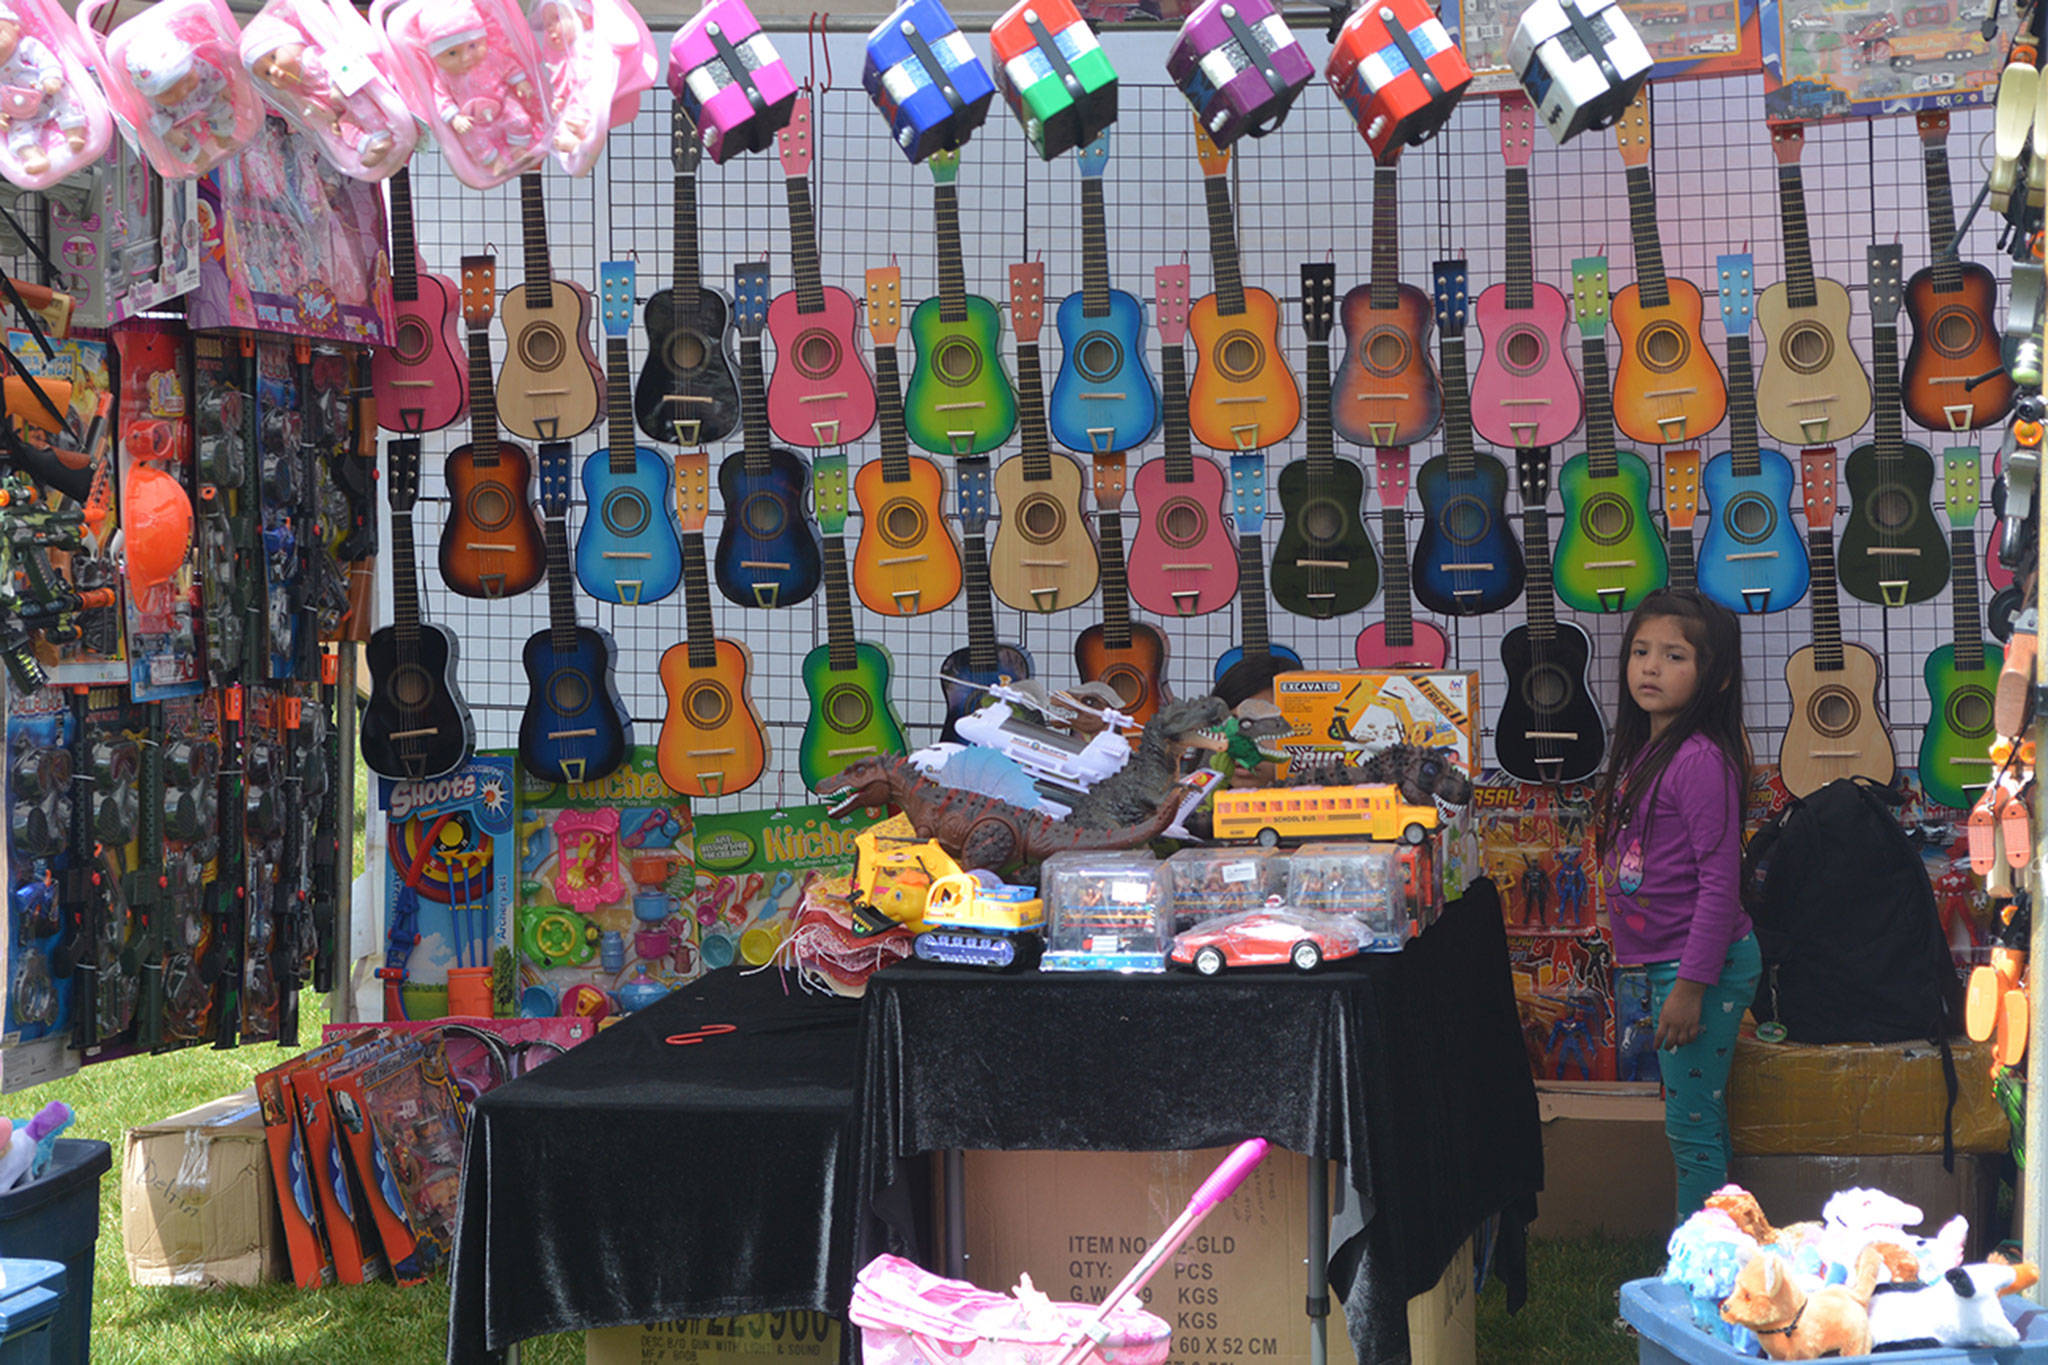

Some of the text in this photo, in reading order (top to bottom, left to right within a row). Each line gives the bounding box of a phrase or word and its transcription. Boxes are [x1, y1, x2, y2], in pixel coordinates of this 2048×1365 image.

[1281, 681, 1339, 691] EXCAVATOR
[1423, 686, 1451, 714] TRUCK
[1068, 1235, 1114, 1254] ITEM
[1069, 1260, 1214, 1280] QTY: PCS
[1177, 1287, 1219, 1305] KGS
[1177, 1312, 1218, 1329] KGS
[1179, 1336, 1201, 1353] 60
[1205, 1337, 1218, 1354] X
[1222, 1337, 1244, 1355] 52
[1248, 1337, 1278, 1355] CM
